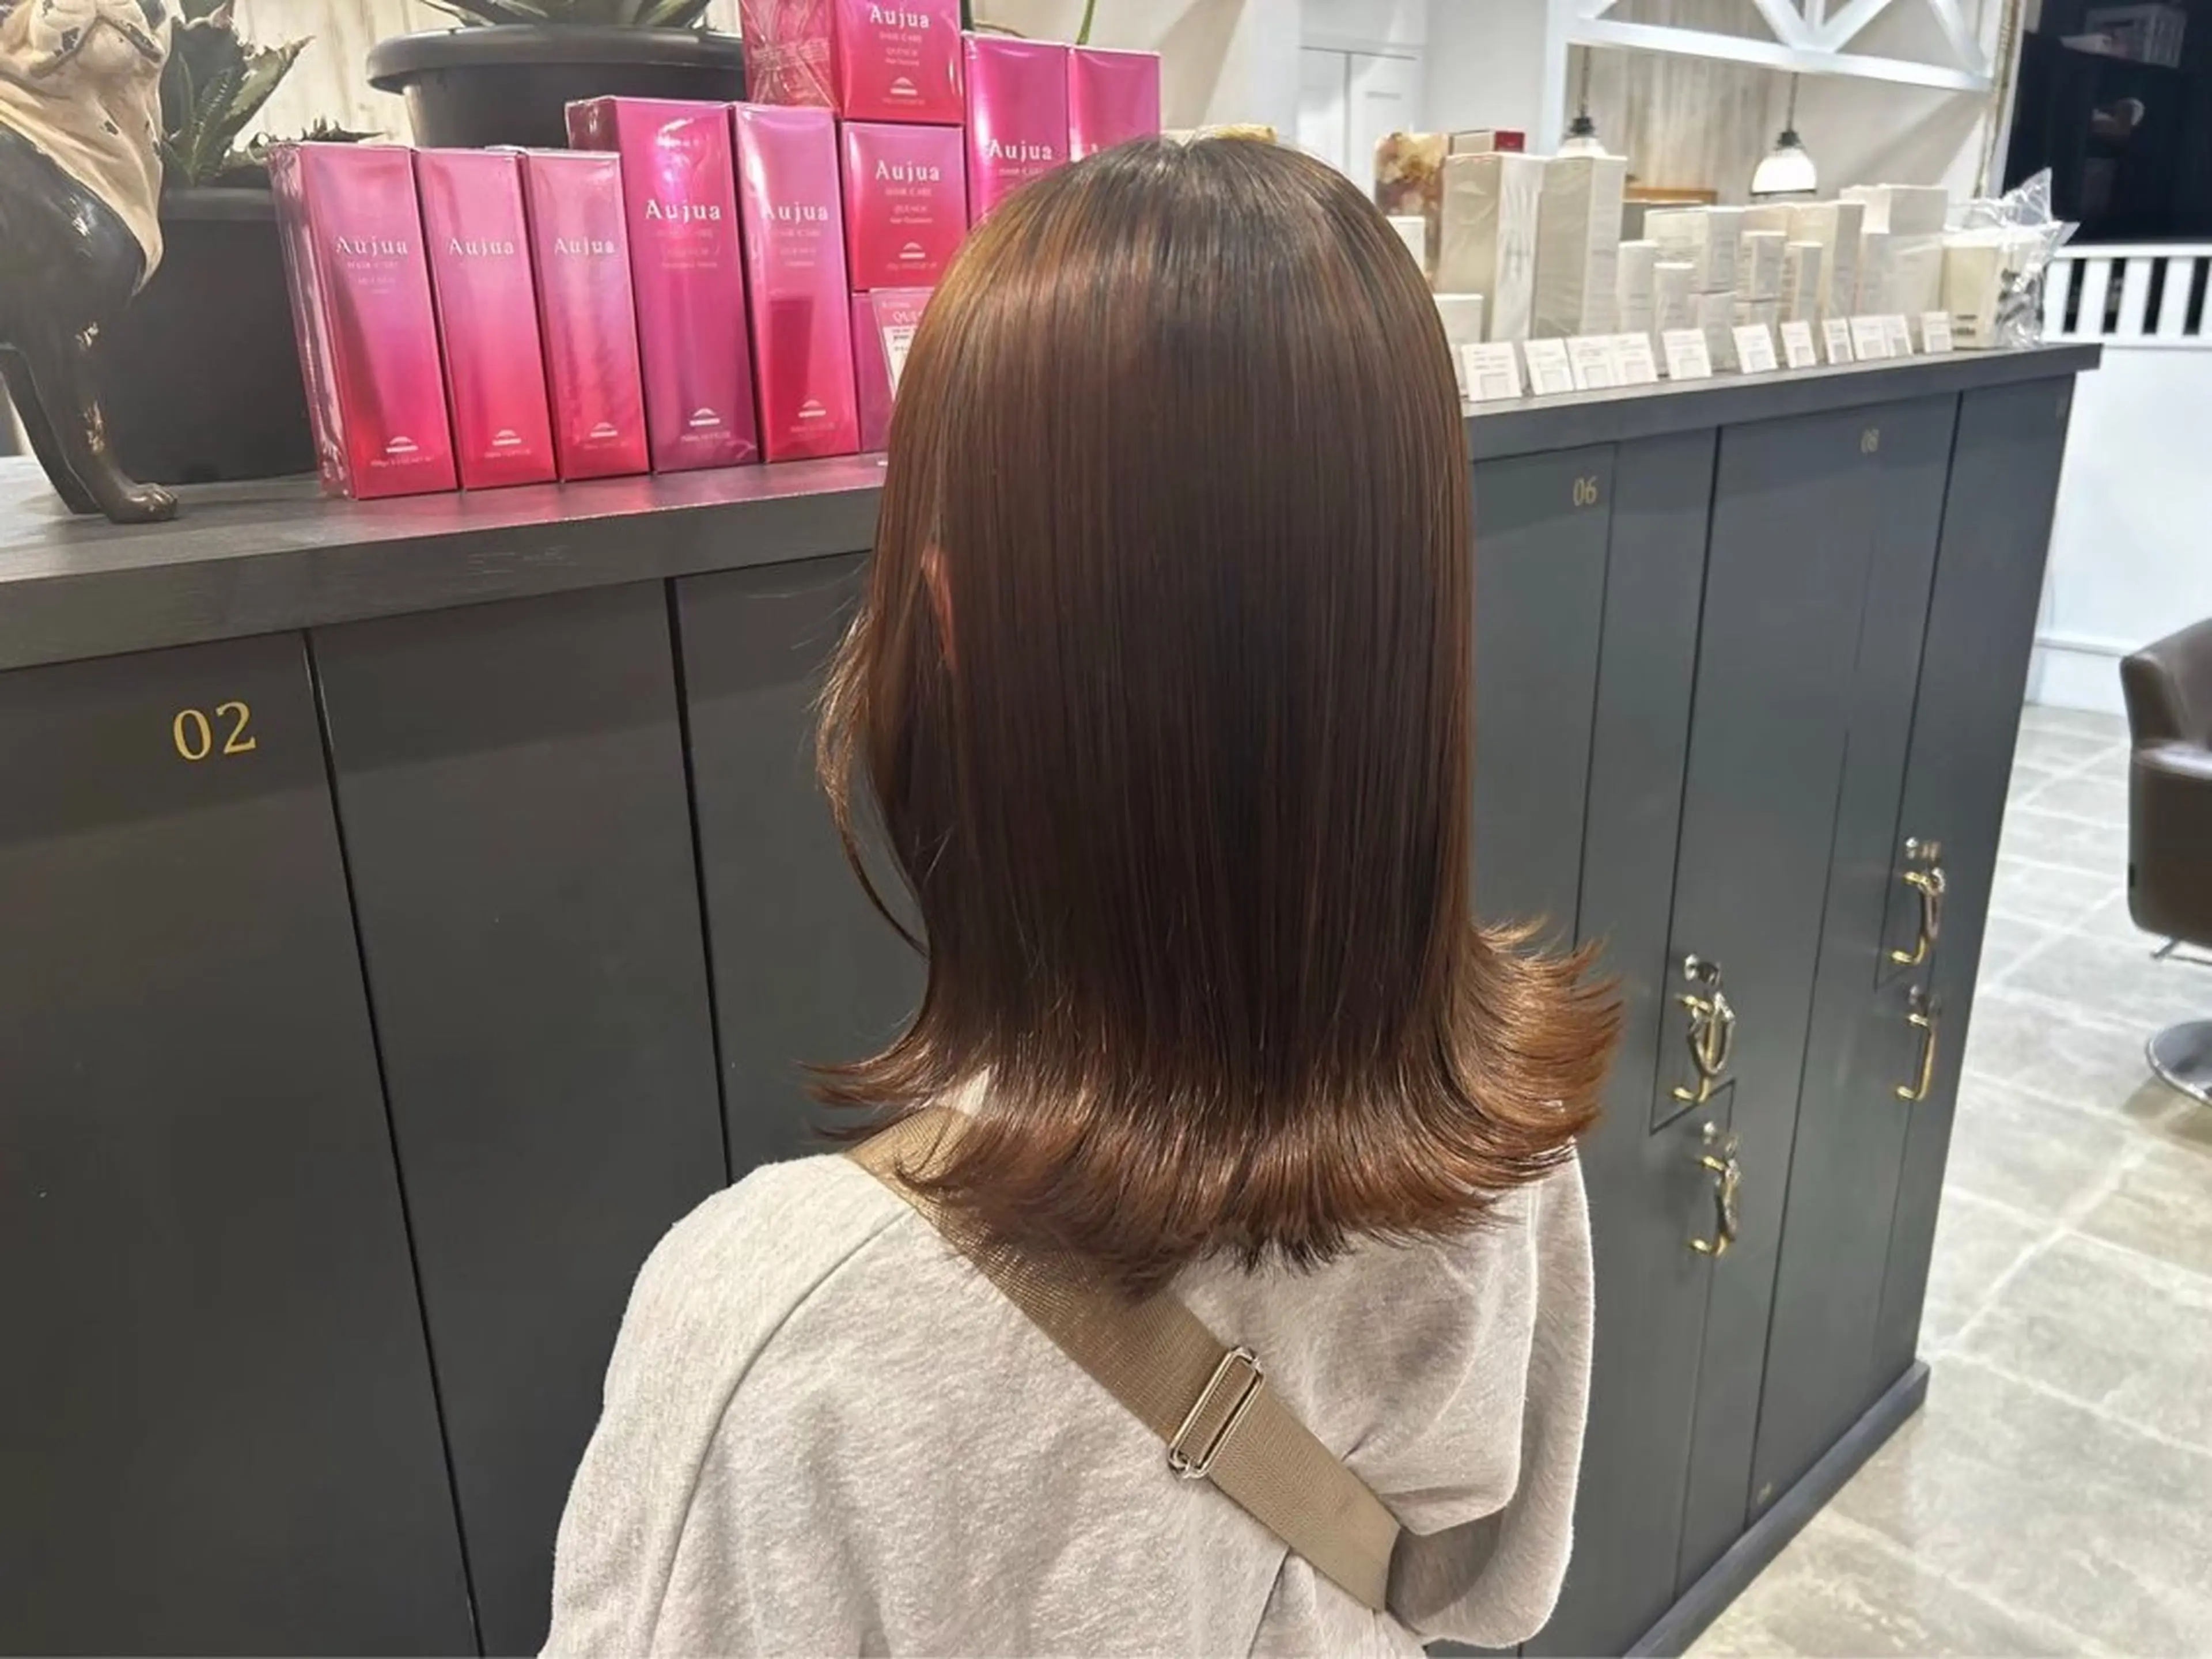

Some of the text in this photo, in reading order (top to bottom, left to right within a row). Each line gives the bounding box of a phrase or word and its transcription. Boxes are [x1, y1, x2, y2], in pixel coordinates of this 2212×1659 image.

[870, 5, 929, 29] Aujua
[989, 139, 1052, 162] Aujua
[876, 160, 940, 184] Aujua
[645, 199, 721, 224] Aujua
[760, 201, 828, 225] Aujua
[336, 236, 408, 258] Aujua
[449, 237, 514, 256] Aujua
[555, 237, 616, 256] Aujua
[1573, 476, 1598, 506] 06
[173, 701, 256, 761] 02
